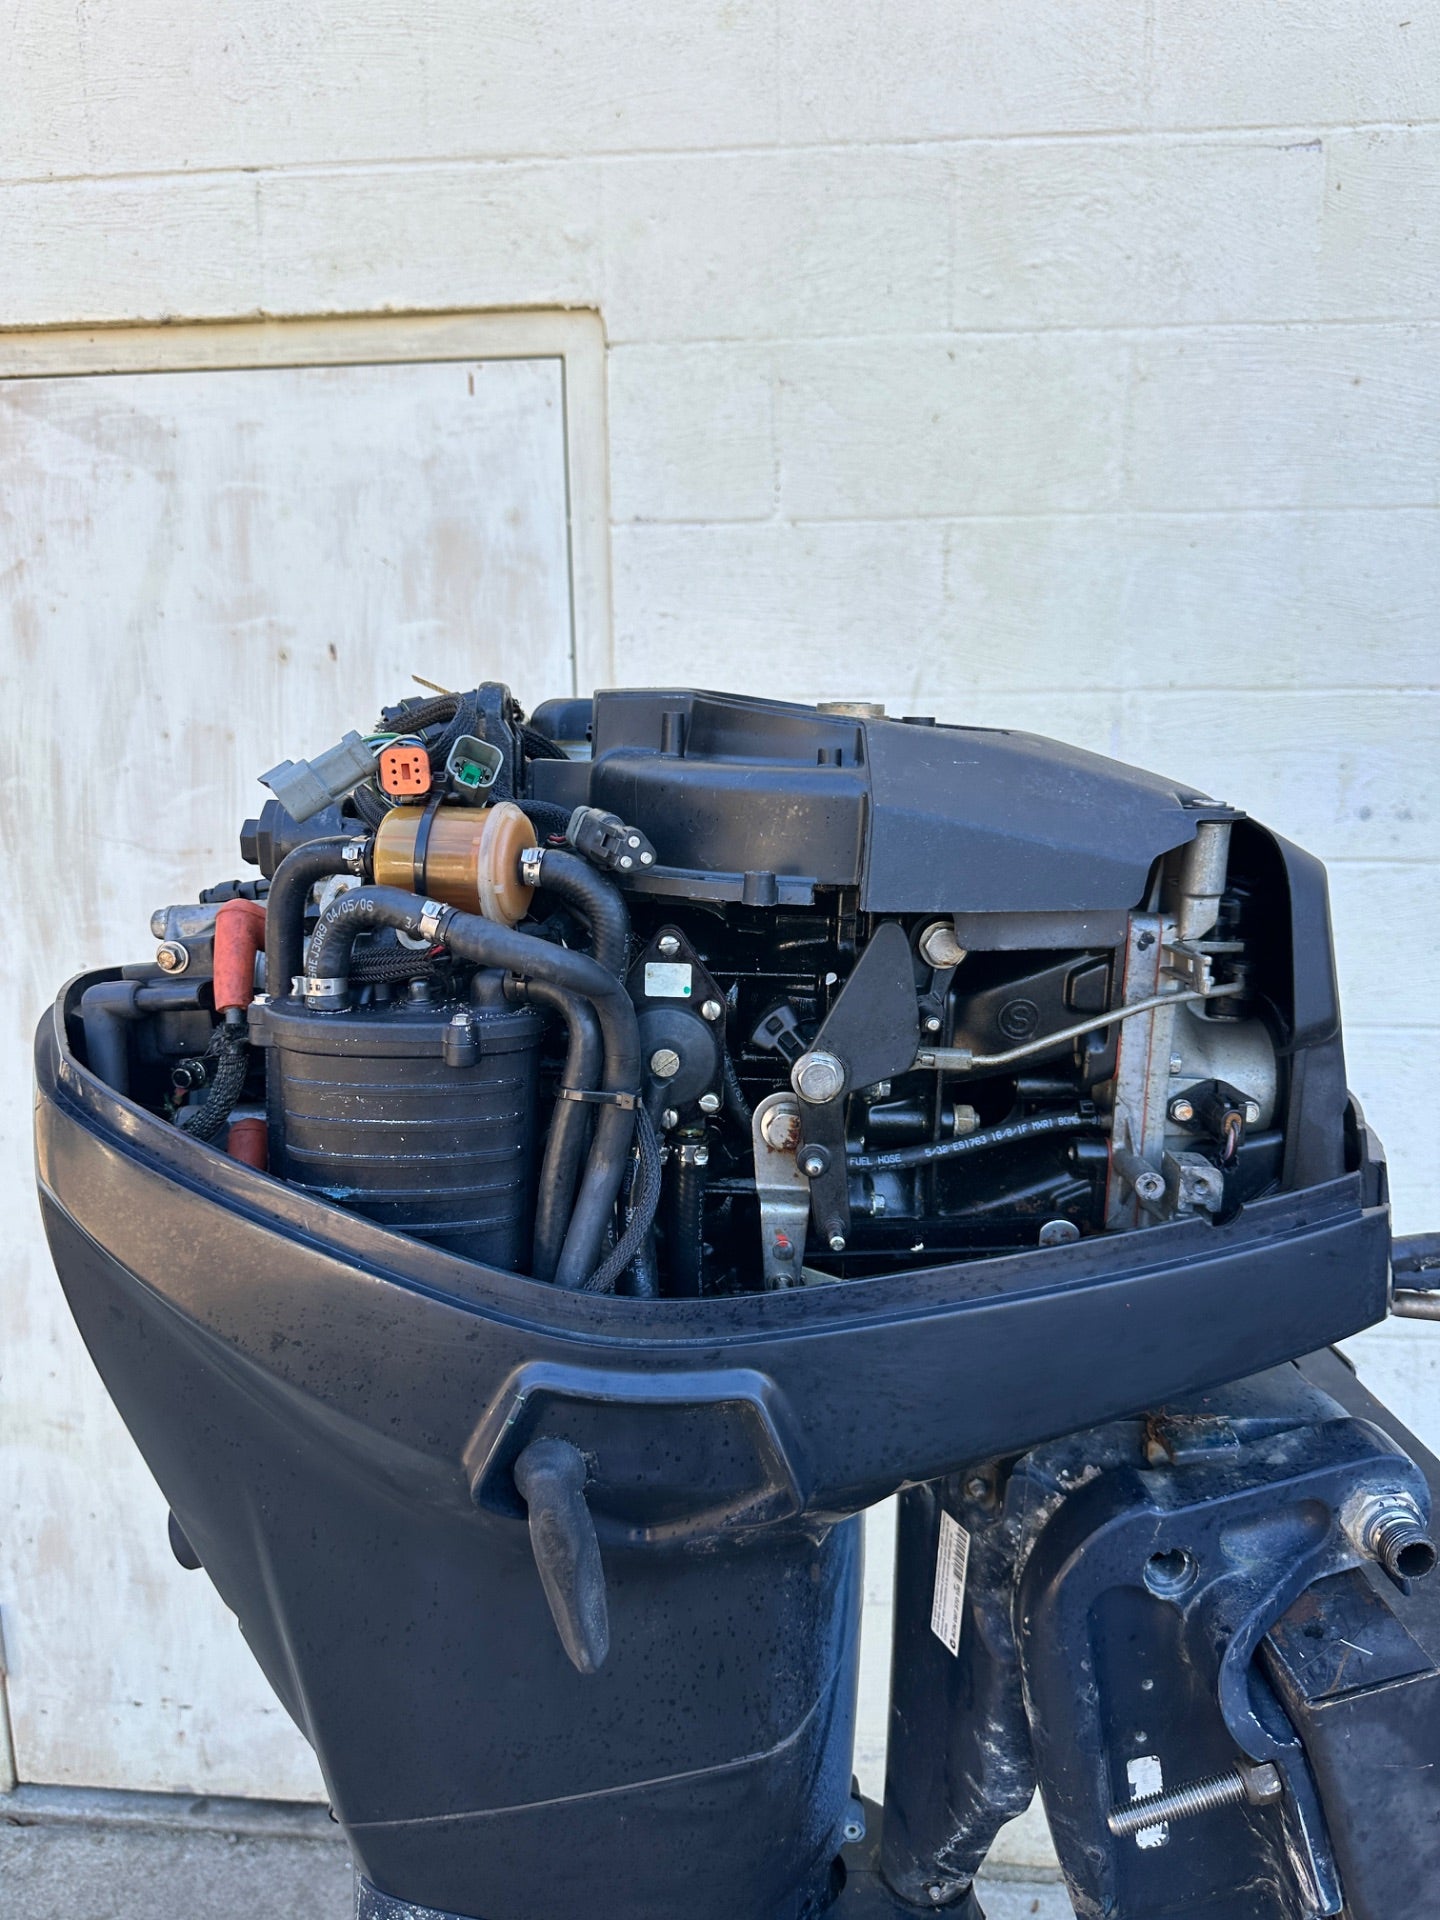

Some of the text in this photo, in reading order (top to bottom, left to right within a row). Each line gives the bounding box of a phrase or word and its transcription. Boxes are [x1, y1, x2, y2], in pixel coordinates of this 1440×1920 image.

[311, 923, 328, 958] J30R9
[326, 898, 374, 923] 04/05/06
[849, 1156, 873, 1166] FUEL
[877, 1154, 902, 1165] HOSE
